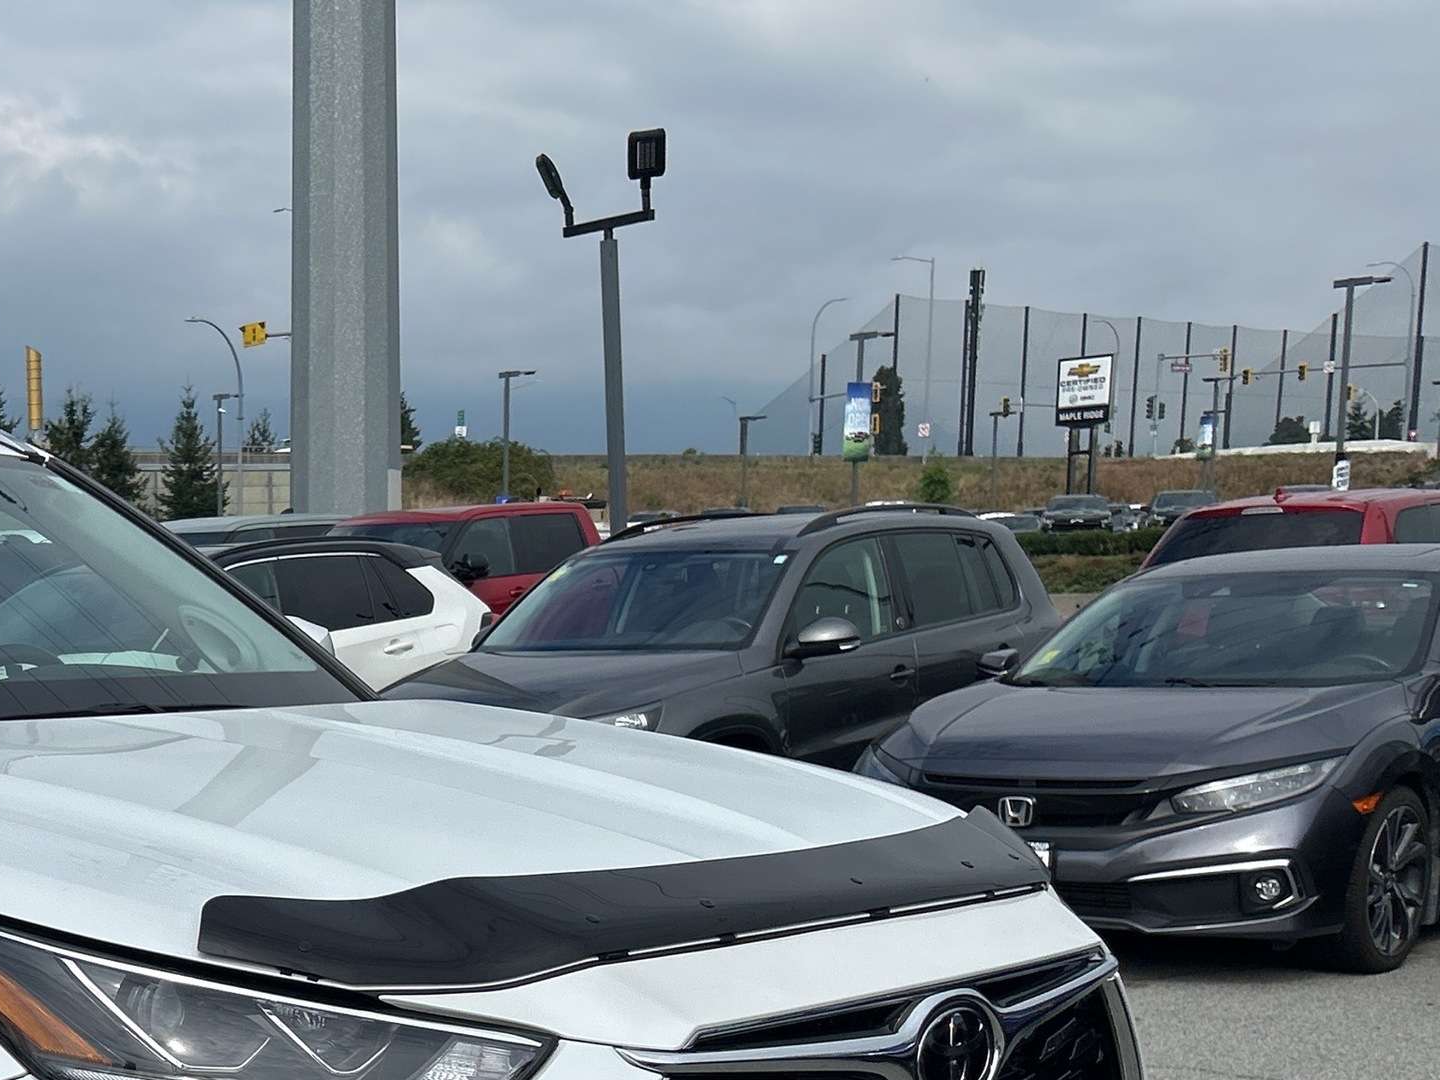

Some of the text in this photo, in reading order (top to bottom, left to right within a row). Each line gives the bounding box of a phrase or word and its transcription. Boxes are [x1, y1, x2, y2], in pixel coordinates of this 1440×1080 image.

[1060, 377, 1106, 387] CERTIFIED
[1059, 410, 1105, 421] MAPLE RIDGE
